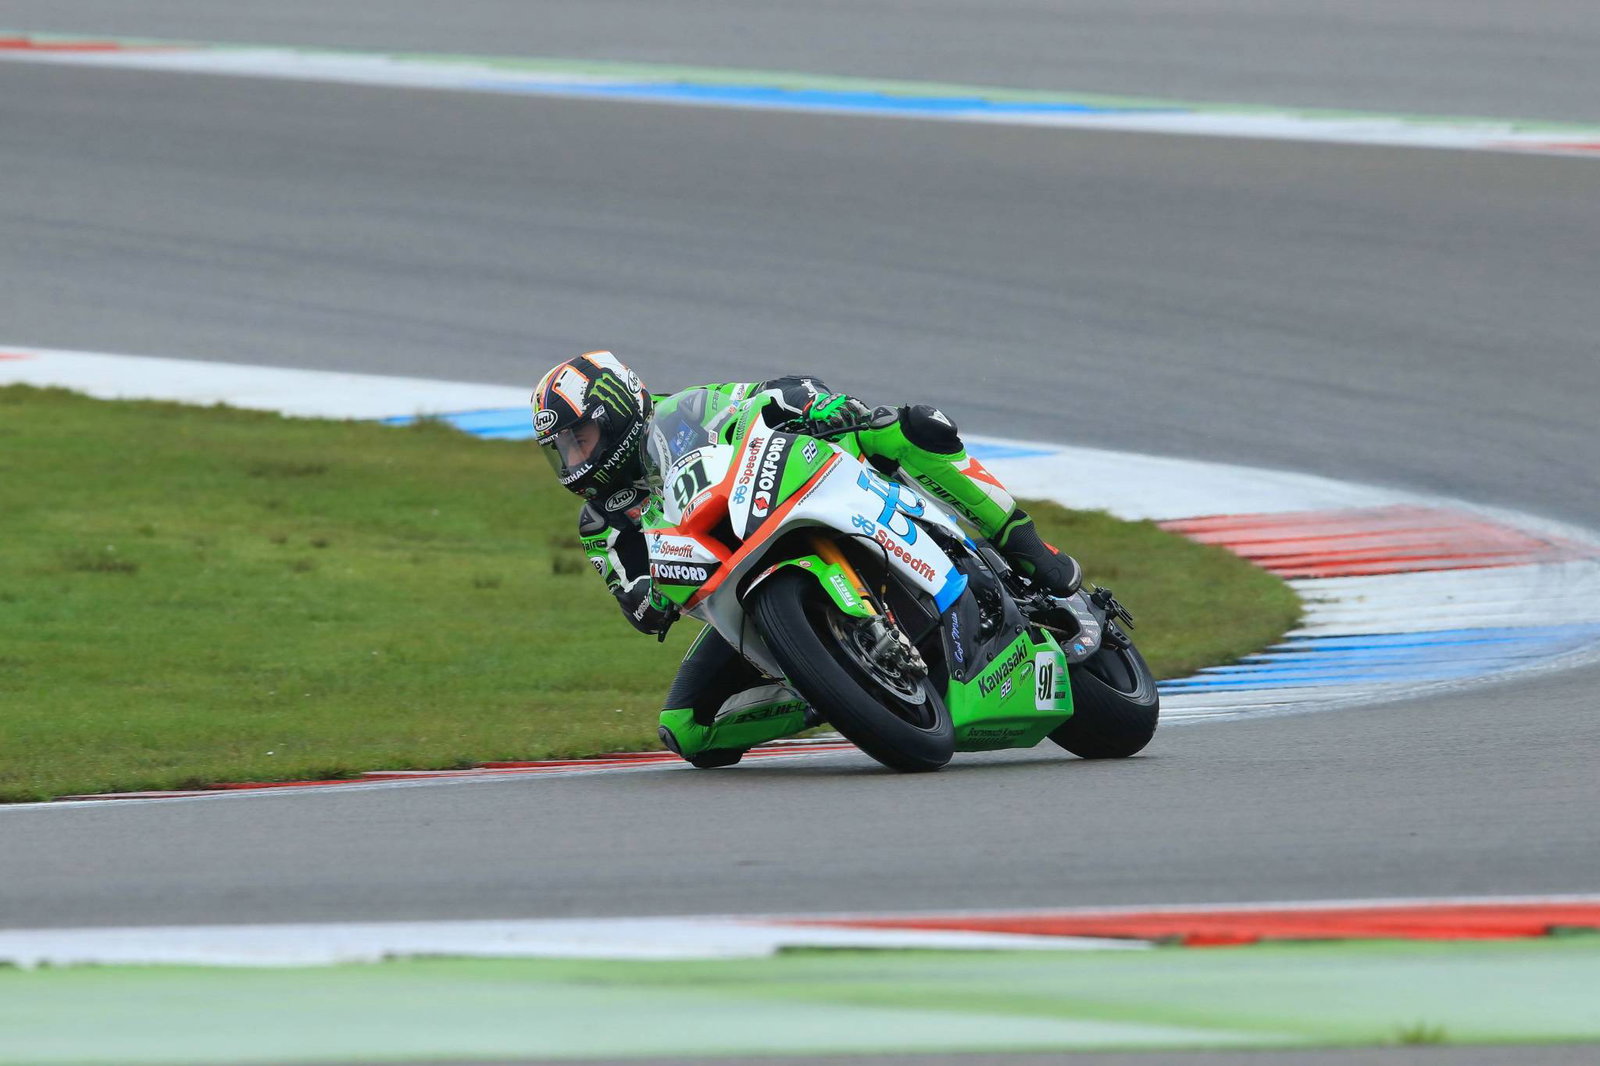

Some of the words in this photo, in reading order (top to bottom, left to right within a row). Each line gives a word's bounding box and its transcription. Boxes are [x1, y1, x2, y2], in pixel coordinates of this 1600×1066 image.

[603, 421, 643, 470] MONSTER
[739, 437, 765, 485] Speedfit
[758, 437, 787, 491] OXFORD
[672, 459, 712, 512] 91
[915, 474, 985, 527] DAINESE
[659, 564, 708, 581] OXFORD
[660, 541, 695, 558] Speedfit
[875, 530, 936, 583] Speedfit
[978, 639, 1028, 698] Kawasaki
[1038, 660, 1054, 700] 91
